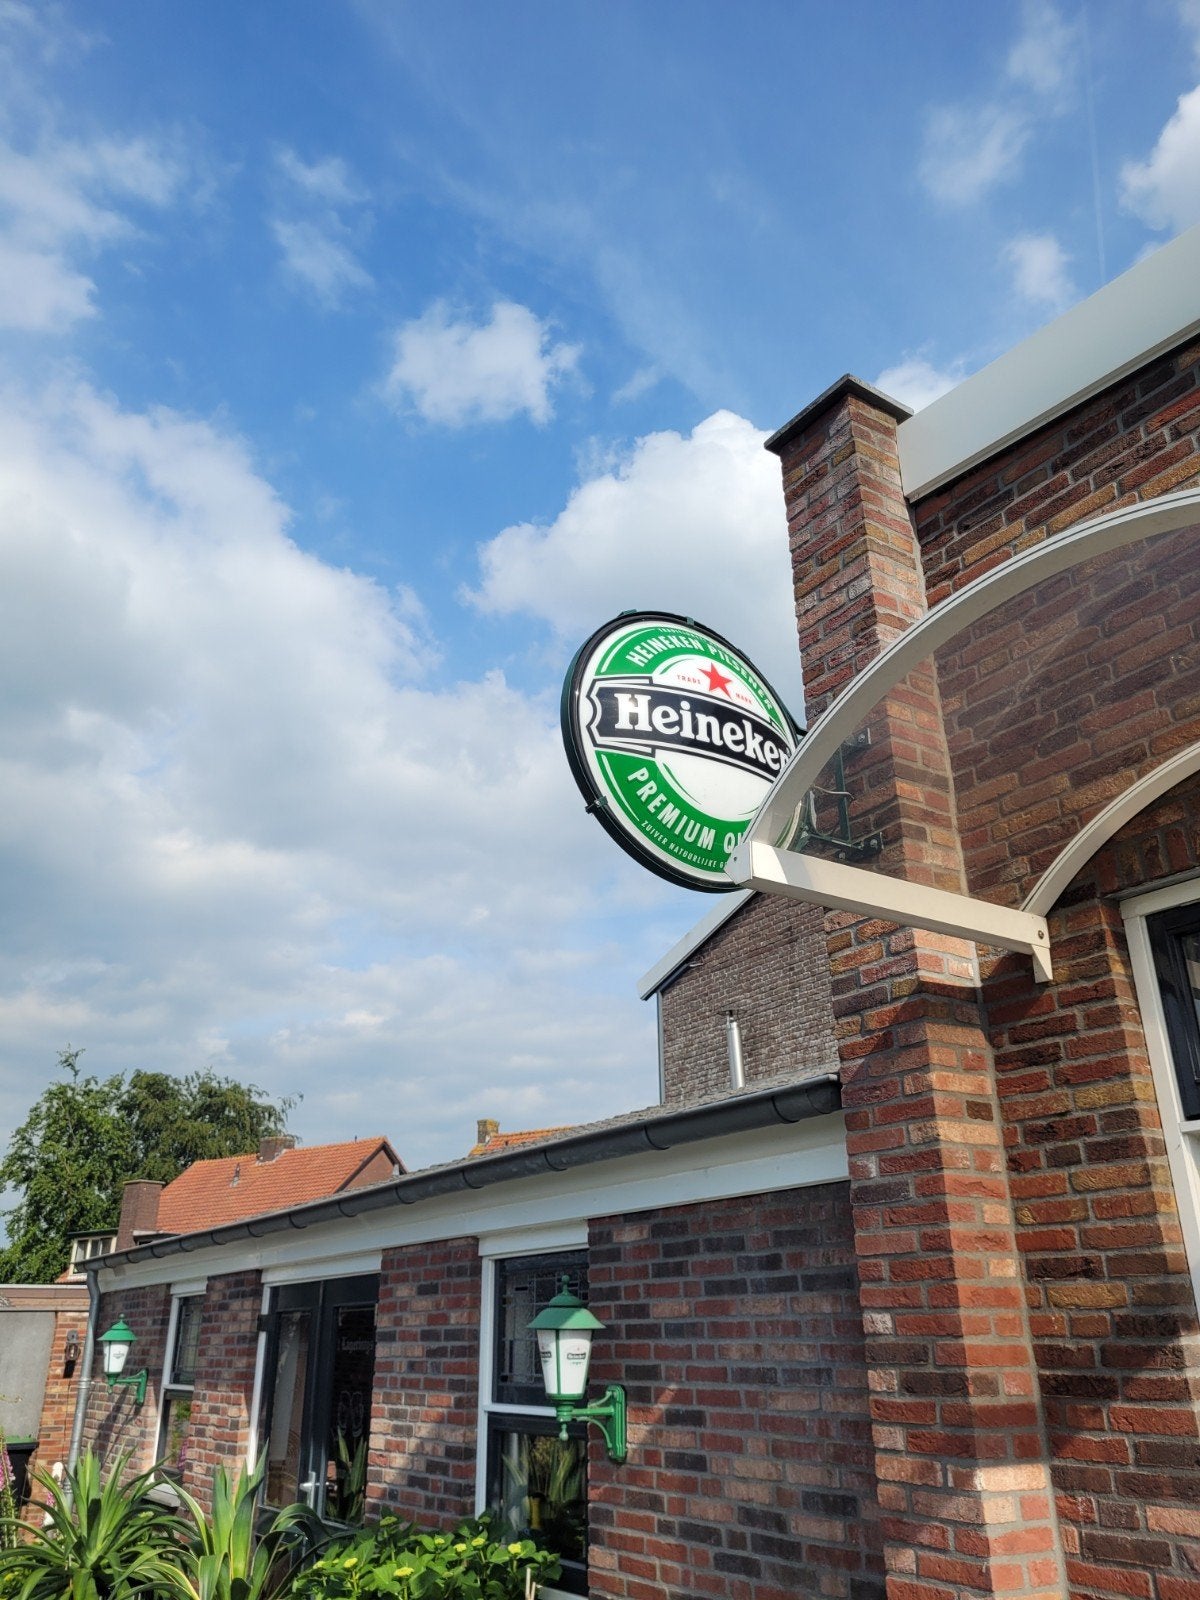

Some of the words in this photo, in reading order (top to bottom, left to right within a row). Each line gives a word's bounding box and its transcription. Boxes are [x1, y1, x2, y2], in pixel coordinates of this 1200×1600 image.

[625, 634, 705, 667] HEINEKEN
[707, 643, 773, 710] PILSENER
[627, 766, 716, 851] PREMIUM
[641, 819, 668, 845] ZUIVER
[668, 842, 718, 869] NATUURLIJKE
